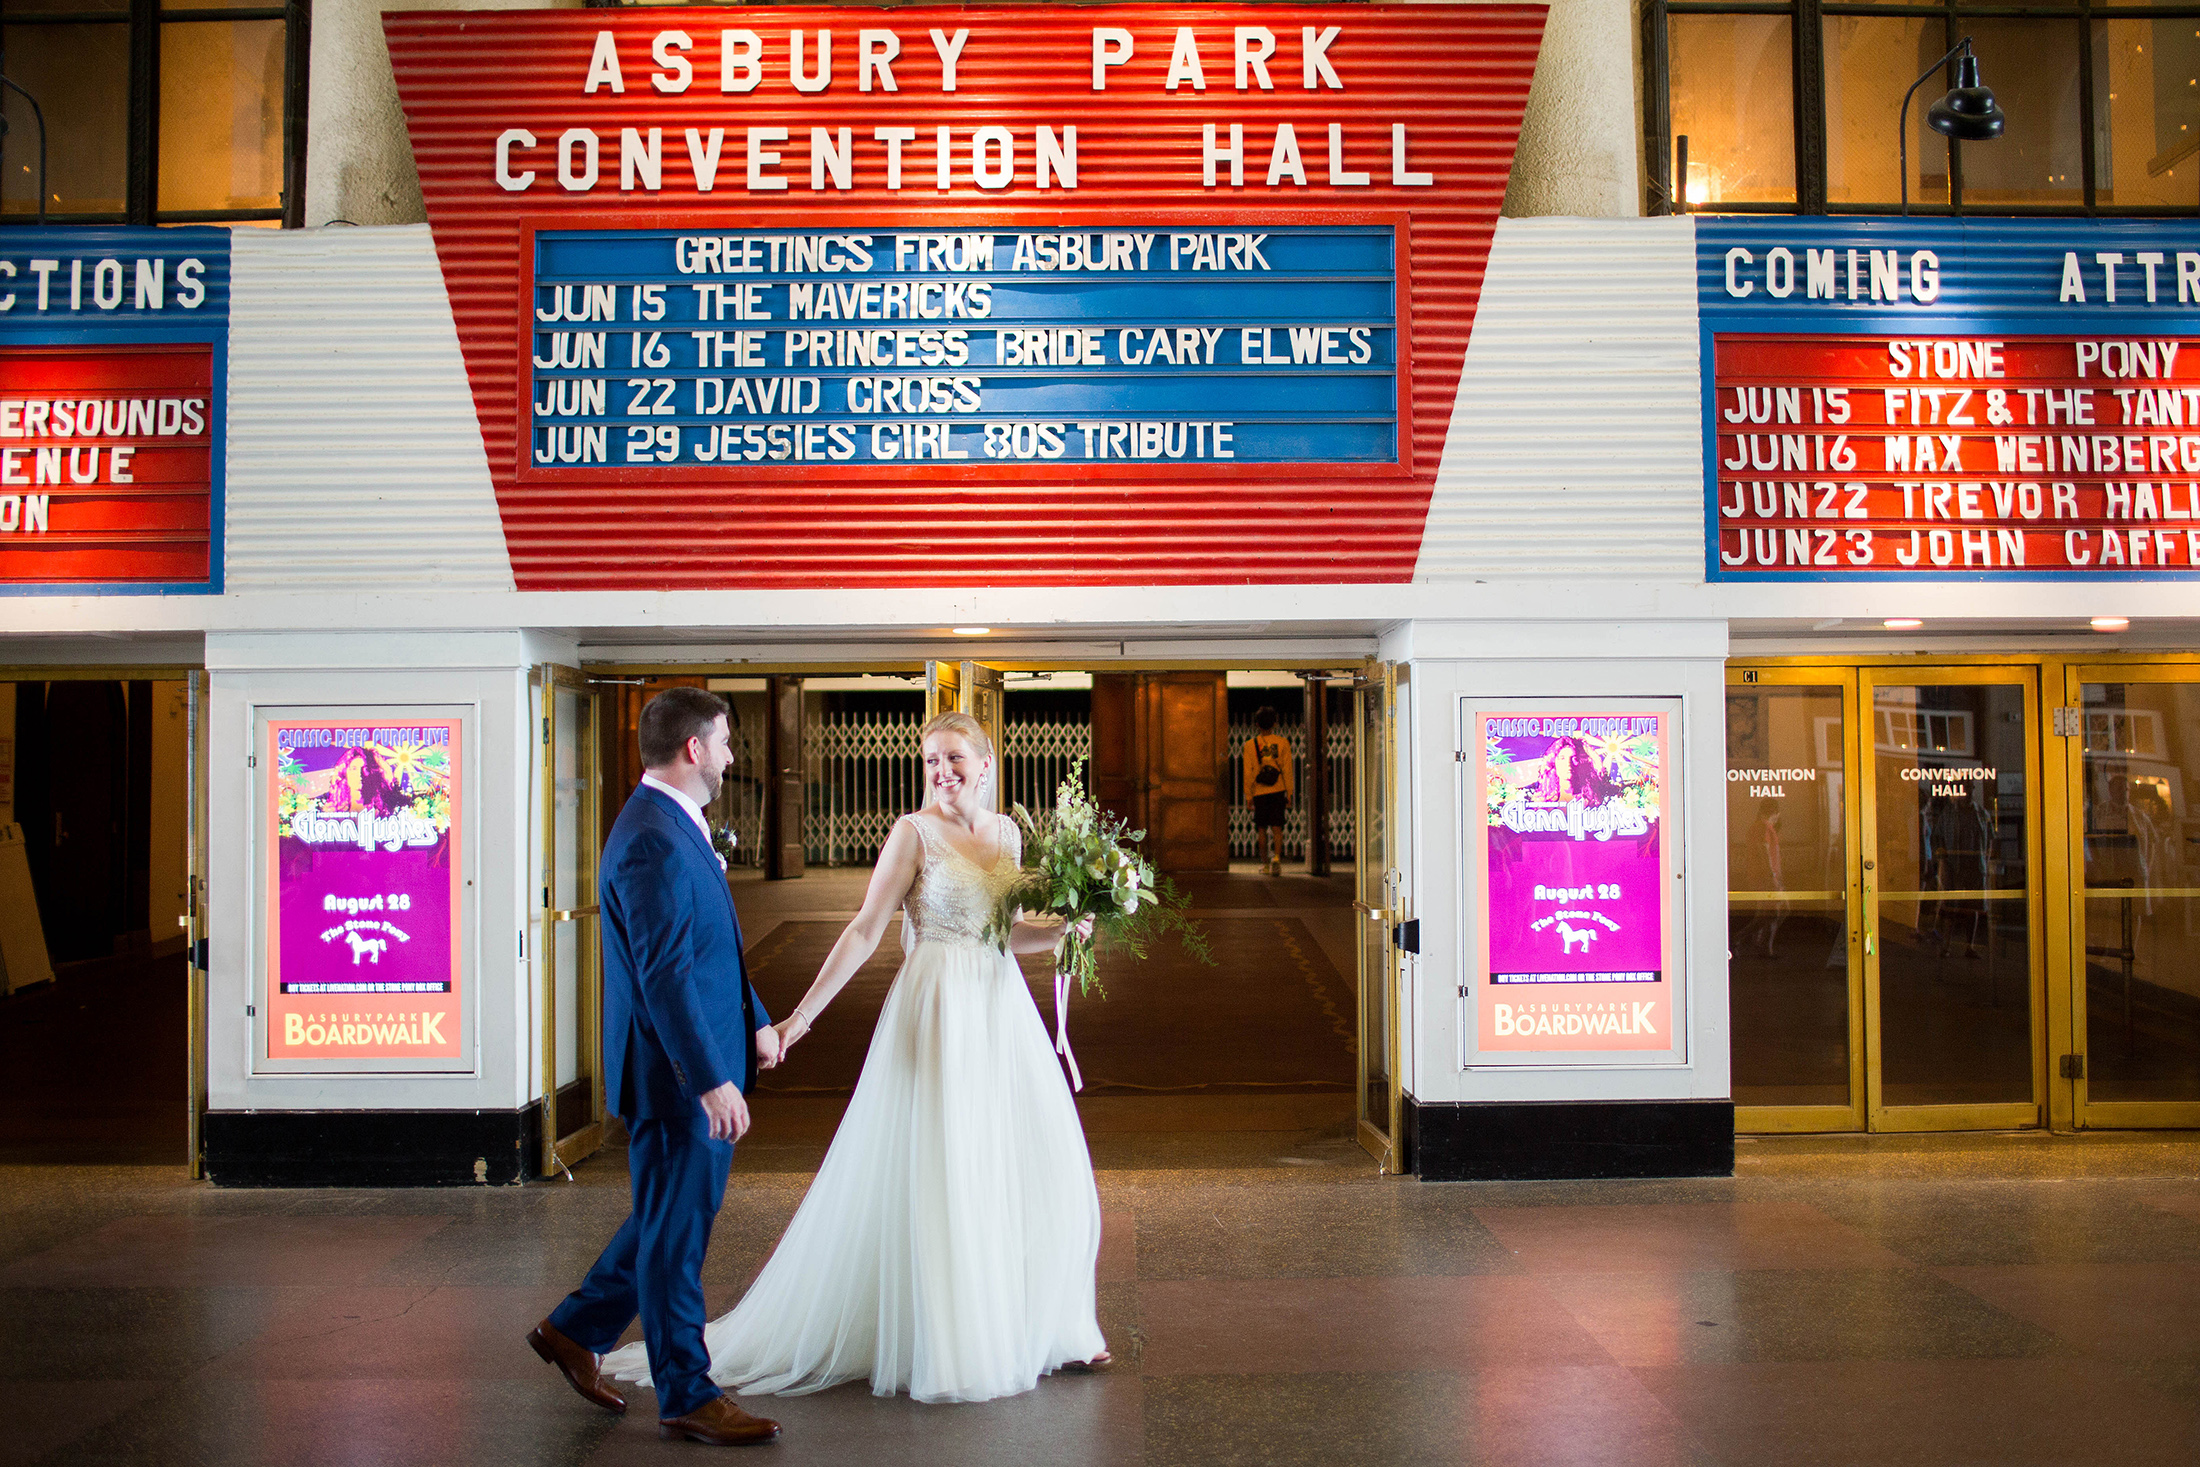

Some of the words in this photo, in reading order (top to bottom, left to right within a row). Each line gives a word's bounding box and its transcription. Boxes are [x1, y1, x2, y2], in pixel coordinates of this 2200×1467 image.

[584, 29, 969, 93] ASBURY
[1092, 27, 1343, 90] PARK
[496, 126, 1078, 191] CONVENTION
[1203, 124, 1433, 187] HALL
[676, 235, 873, 274] GREETINGS
[897, 235, 994, 272] FROM
[1012, 234, 1155, 271] ASBURY
[1170, 234, 1271, 271] PARK
[1725, 247, 1939, 302] COMING
[2059, 252, 2200, 303] ATTR
[536, 285, 616, 322] JUN
[631, 285, 666, 321] 15
[693, 284, 772, 321] THE
[790, 283, 992, 320] MAVERICKS
[533, 332, 605, 369] JUN
[632, 331, 671, 368] 16
[692, 331, 765, 368] THE
[785, 330, 969, 367] PRINCESS
[997, 329, 1105, 366] BRIDE
[1119, 329, 1224, 366] CARY
[1241, 328, 1372, 365] ELWES
[1889, 341, 2005, 378] STONE
[2076, 342, 2179, 378] PONY
[535, 379, 606, 416] JUN
[627, 379, 676, 416] 22
[696, 378, 820, 415] DAVID
[847, 376, 982, 414] CROSS
[1885, 388, 1975, 425] FITZ
[2113, 388, 2200, 426] TANT
[0, 399, 205, 437] ERSOUNDS
[536, 426, 607, 463] JUN
[627, 425, 680, 462] 29
[694, 424, 856, 462] JESSIES
[871, 424, 968, 461] GIRL
[984, 423, 1066, 459] 80S
[1077, 422, 1234, 459] TRIBUTE
[1885, 435, 1963, 472] MAX
[1994, 435, 2200, 473] WEINBERG
[2, 447, 135, 484] ENUE
[0, 495, 49, 532] ON
[1894, 483, 2080, 519] TREVOR
[1896, 530, 2025, 567] JOHN
[278, 729, 332, 748] CLASSIC
[335, 728, 370, 747] DEEP
[372, 728, 420, 747] PURPLE
[422, 727, 449, 746] LIVE
[1486, 719, 1540, 738] CLASSIC
[1543, 718, 1578, 737] DEEP
[1581, 718, 1629, 736] PURPLE
[1631, 717, 1657, 736] LIVE
[1750, 786, 1785, 797] HALL
[1900, 767, 1996, 781] CONVENTION
[1931, 785, 1967, 797] HALL
[324, 894, 384, 915] August
[387, 893, 411, 911] 28
[1534, 884, 1594, 905] August
[1598, 883, 1621, 900] 28
